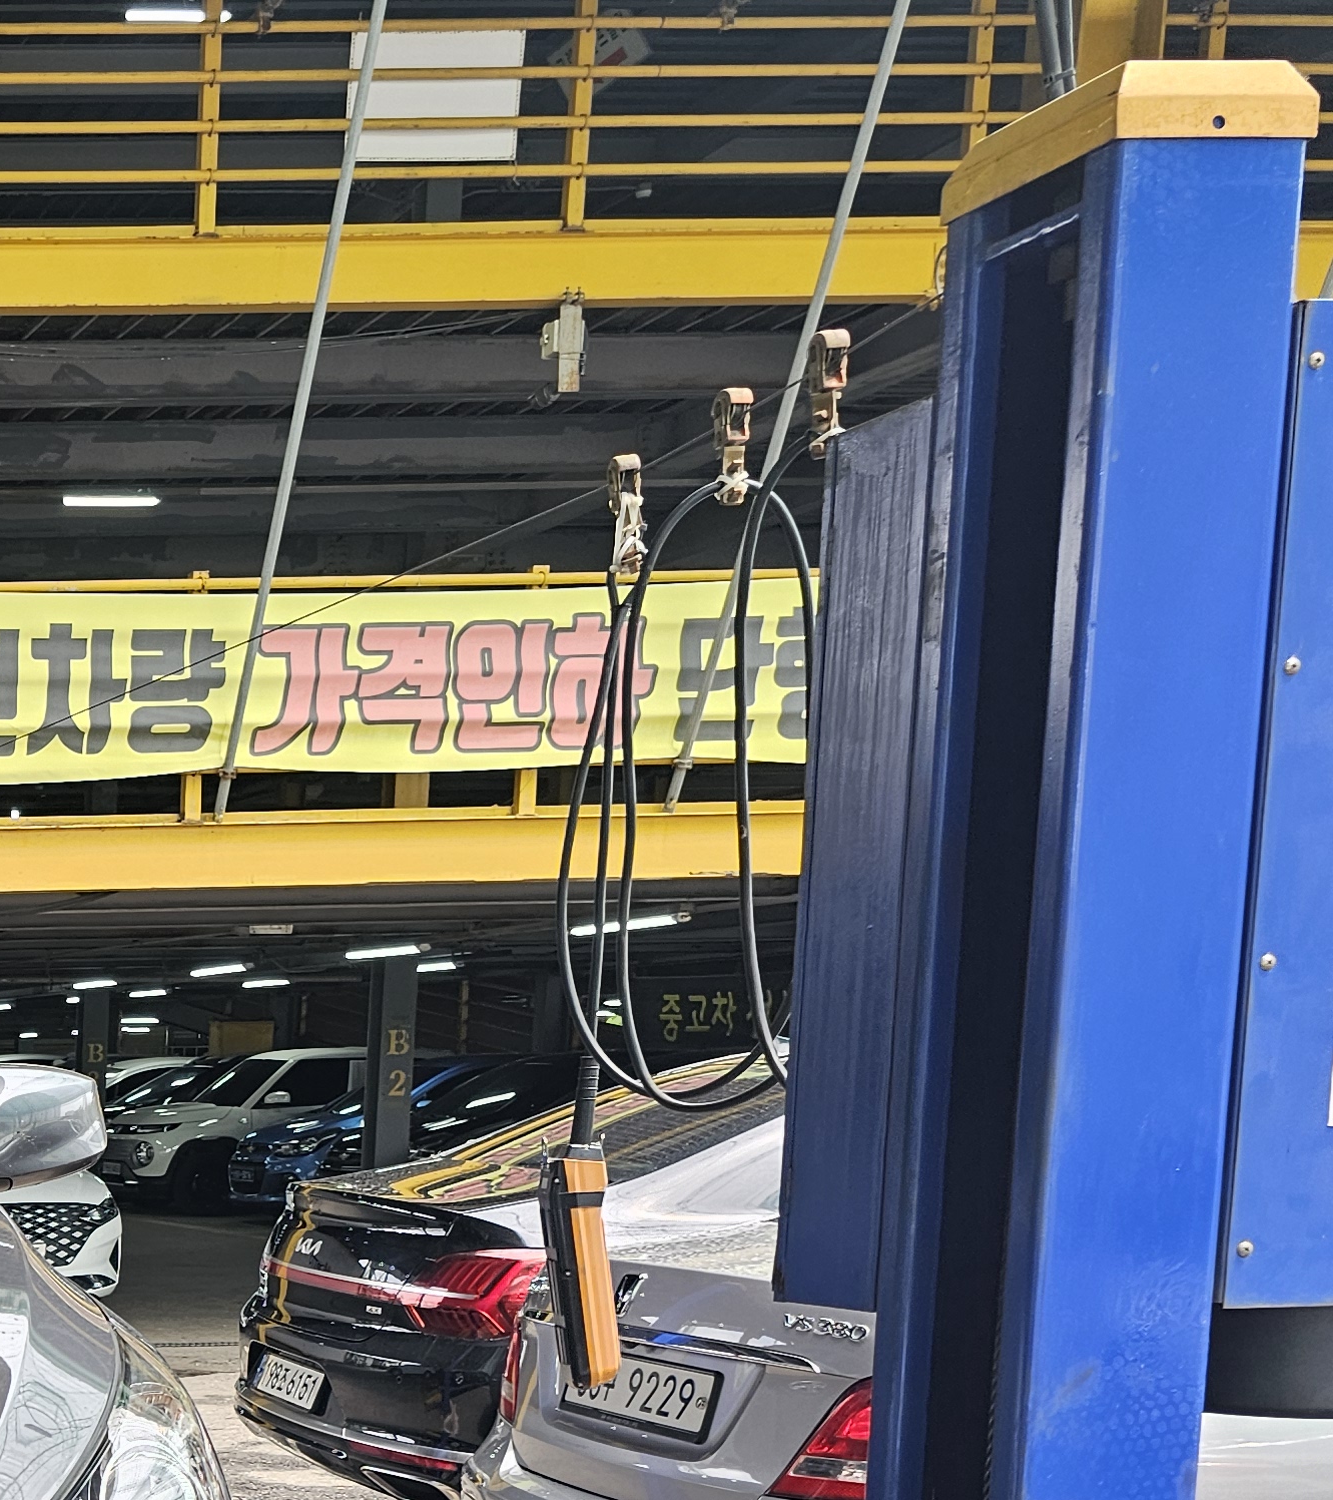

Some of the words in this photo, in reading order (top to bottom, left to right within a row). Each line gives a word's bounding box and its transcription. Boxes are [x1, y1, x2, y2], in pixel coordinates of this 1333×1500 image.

[248, 611, 658, 757] 가격인하
[659, 991, 737, 1042] 중고차
[86, 1043, 104, 1063] B
[387, 1029, 410, 1056] B
[388, 1070, 407, 1097] 2
[624, 1367, 696, 1421] 9229
